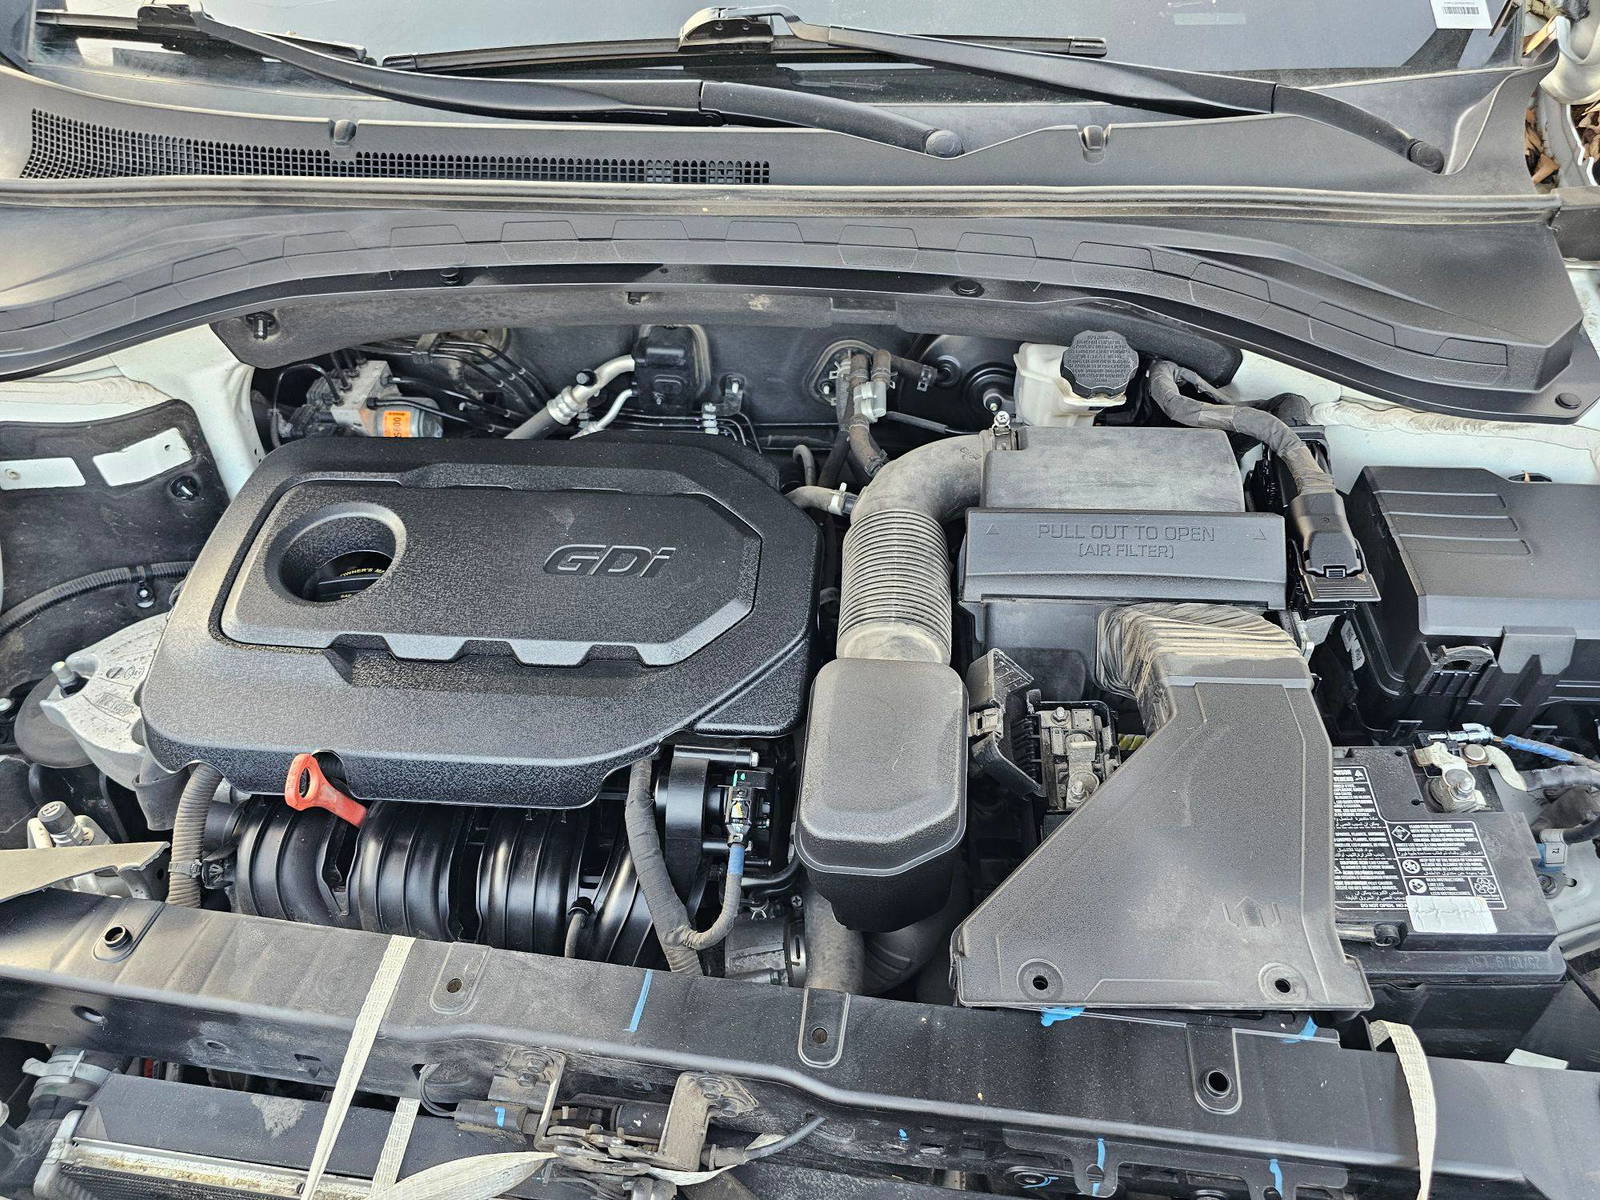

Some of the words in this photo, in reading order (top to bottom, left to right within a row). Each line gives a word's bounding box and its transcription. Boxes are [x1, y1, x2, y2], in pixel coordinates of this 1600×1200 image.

[1037, 523, 1085, 539] PULL
[1091, 524, 1129, 540] OUT
[1133, 525, 1159, 540] TO
[1165, 526, 1216, 542] OPEN
